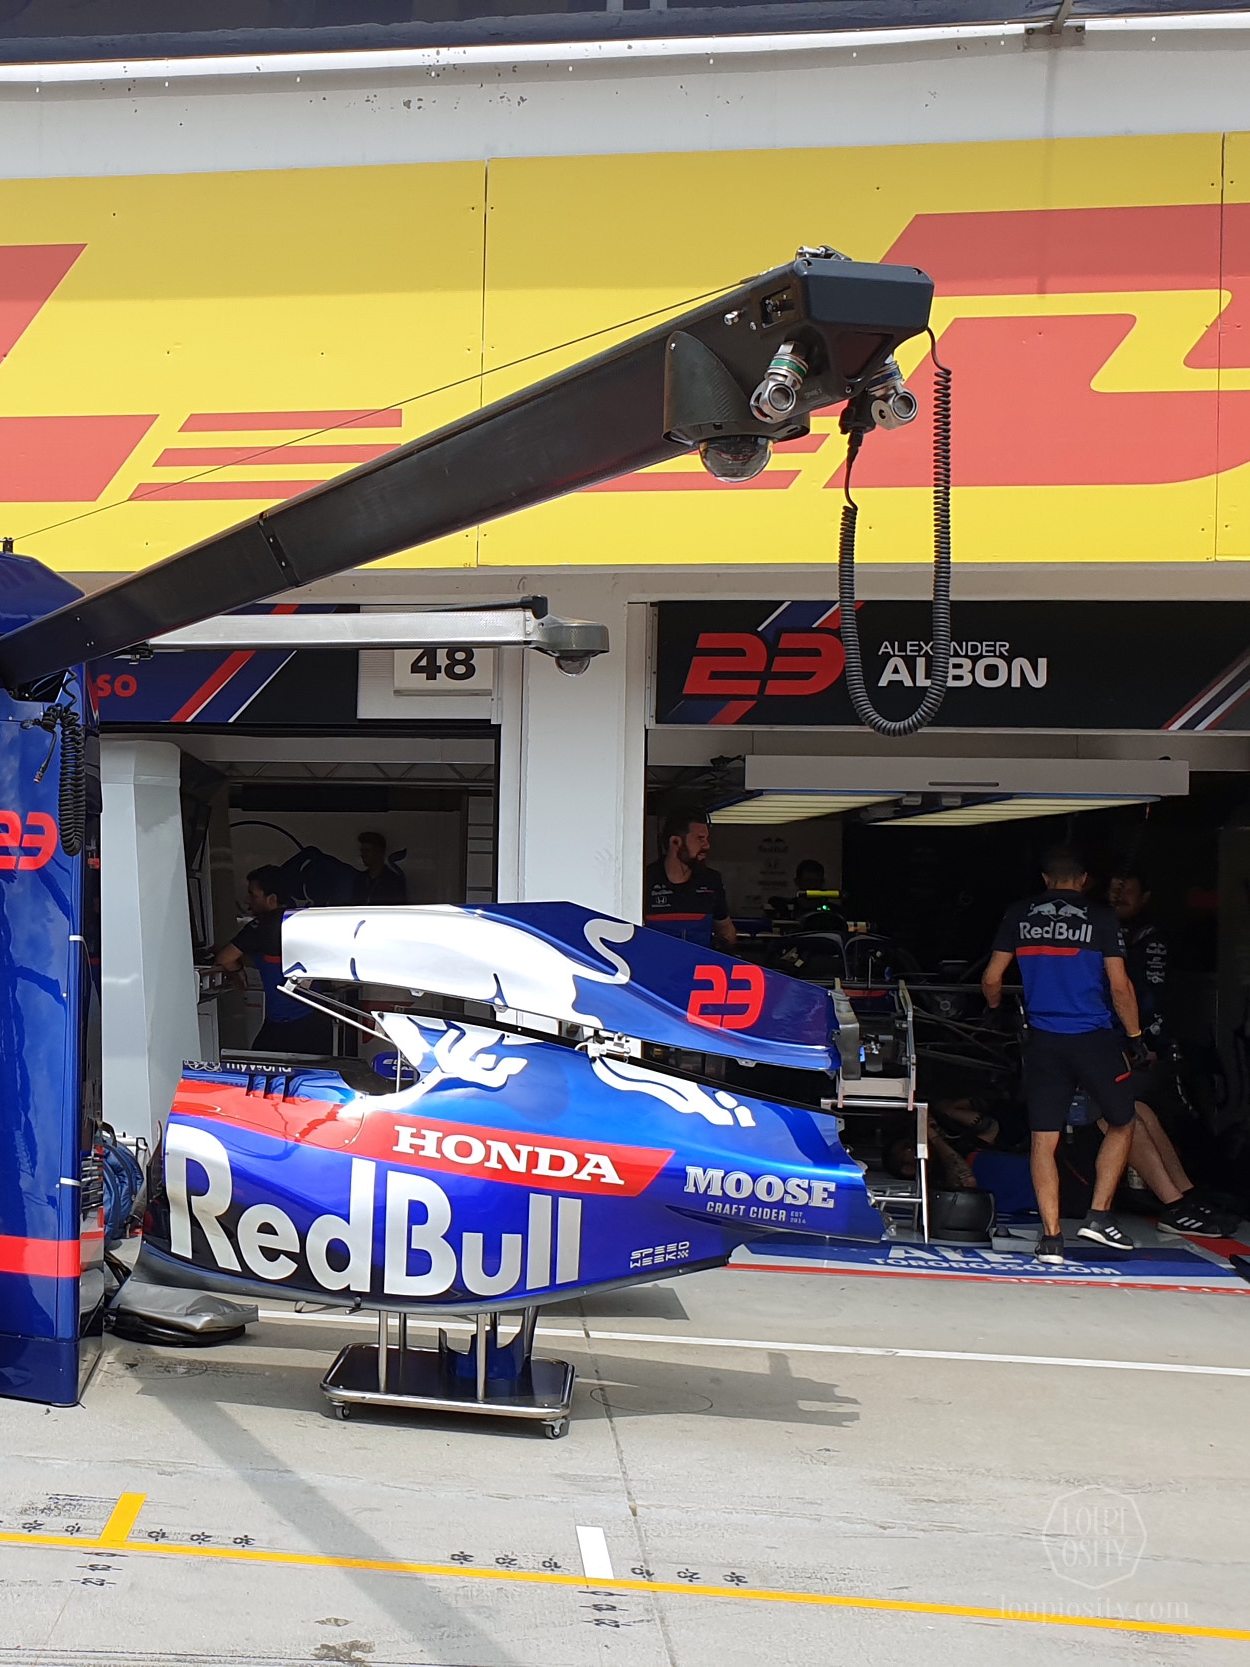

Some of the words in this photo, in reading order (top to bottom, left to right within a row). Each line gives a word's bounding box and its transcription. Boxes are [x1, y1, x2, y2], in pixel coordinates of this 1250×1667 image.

[878, 641, 1010, 656] ALEXNDER
[410, 648, 477, 681] 48
[682, 633, 846, 695] 23
[878, 657, 1048, 688] ALBON
[687, 964, 765, 1029] 23
[393, 1124, 626, 1184] HONDA
[684, 1165, 837, 1209] MOOSE
[706, 1201, 746, 1217] CRAFT
[750, 1206, 787, 1222] CIDER
[630, 1252, 678, 1268] WEEK
[631, 1241, 690, 1259] SPEED
[888, 1245, 1084, 1266] ALE
[867, 1257, 1123, 1275] TOROROSSO.COM
